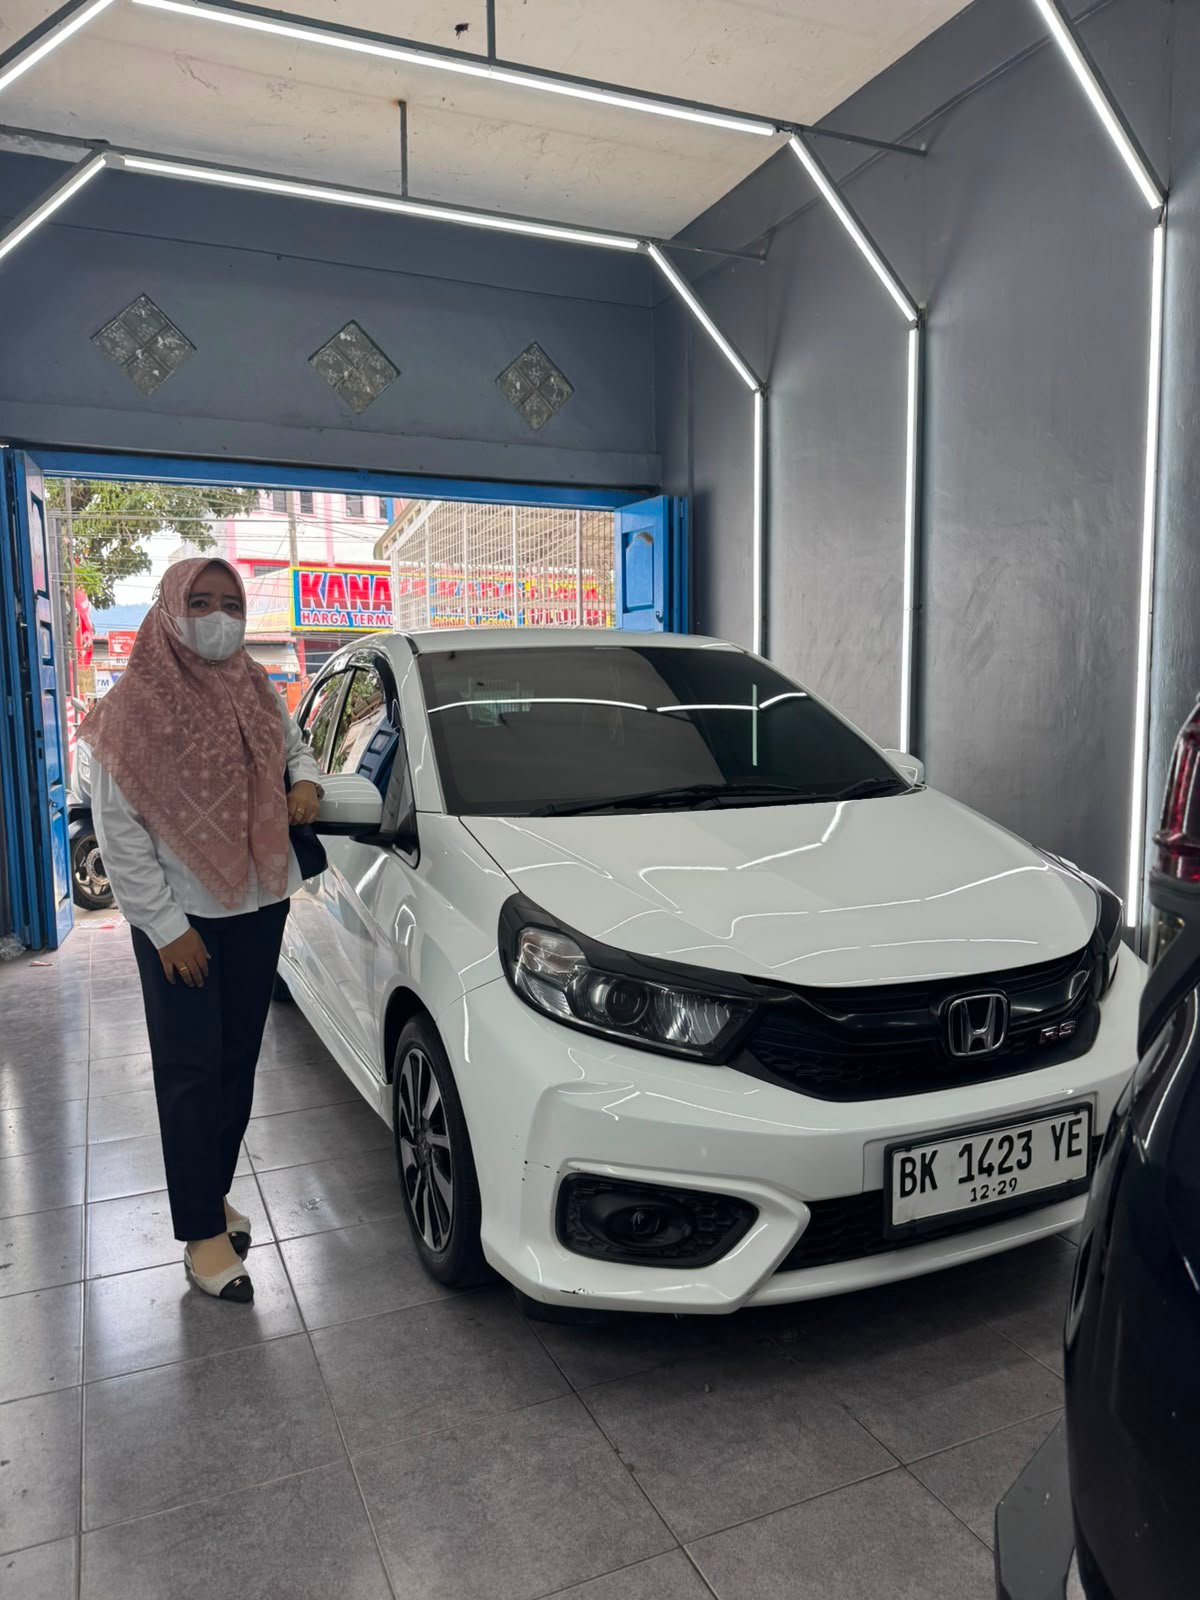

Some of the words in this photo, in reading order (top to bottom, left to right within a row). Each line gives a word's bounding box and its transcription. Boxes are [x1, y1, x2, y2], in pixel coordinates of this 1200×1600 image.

[301, 611, 348, 625] HARGA
[900, 1150, 937, 1198] BK
[958, 1130, 1033, 1185] 1423
[1051, 1119, 1082, 1162] YE
